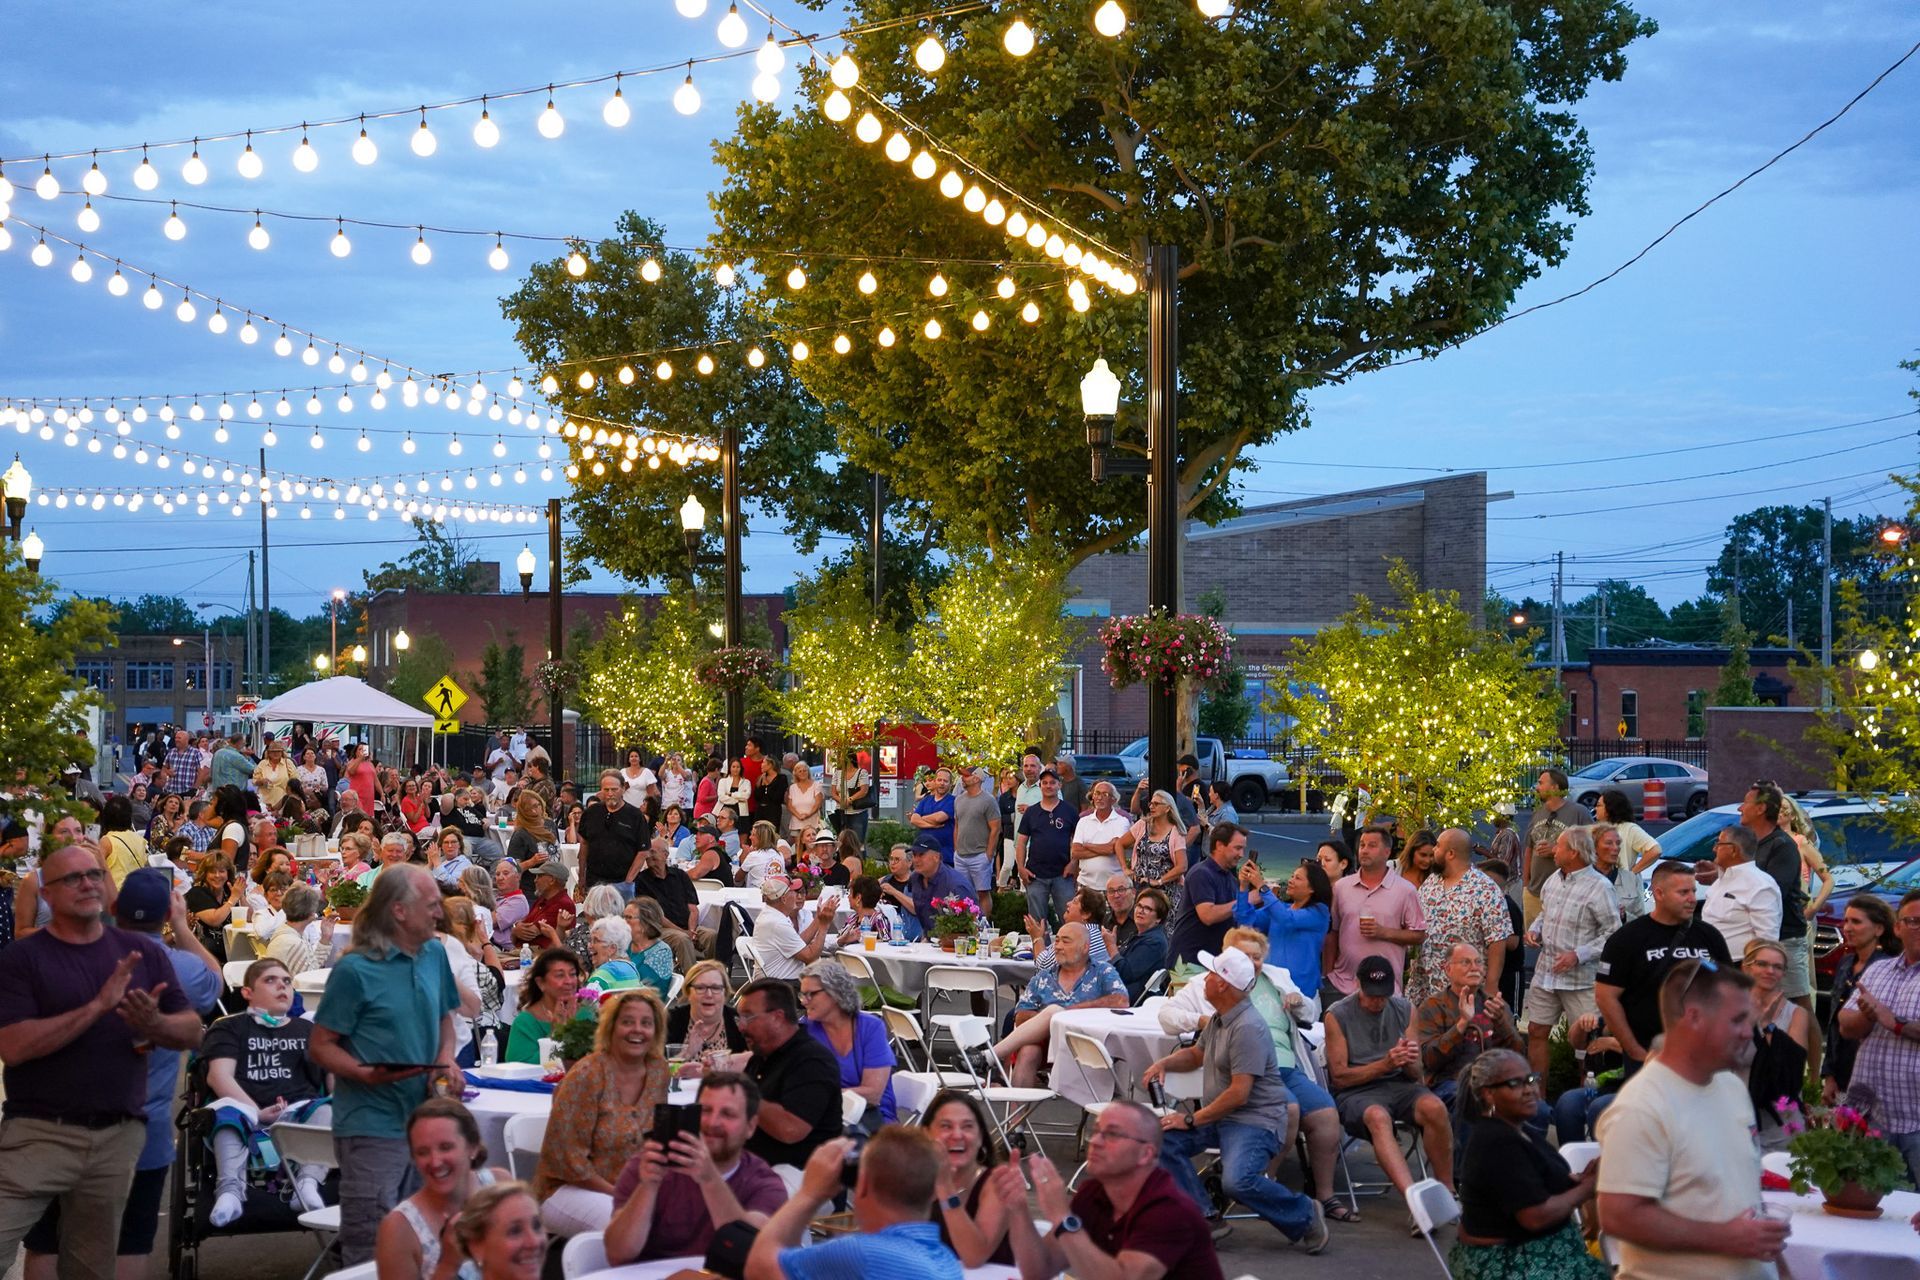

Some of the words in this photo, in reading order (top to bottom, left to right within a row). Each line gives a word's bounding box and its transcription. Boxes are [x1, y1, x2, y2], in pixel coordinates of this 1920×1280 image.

[247, 1037, 307, 1051] SUPPORT
[247, 1053, 281, 1068] LIVE
[247, 1067, 292, 1081] MUSIC
